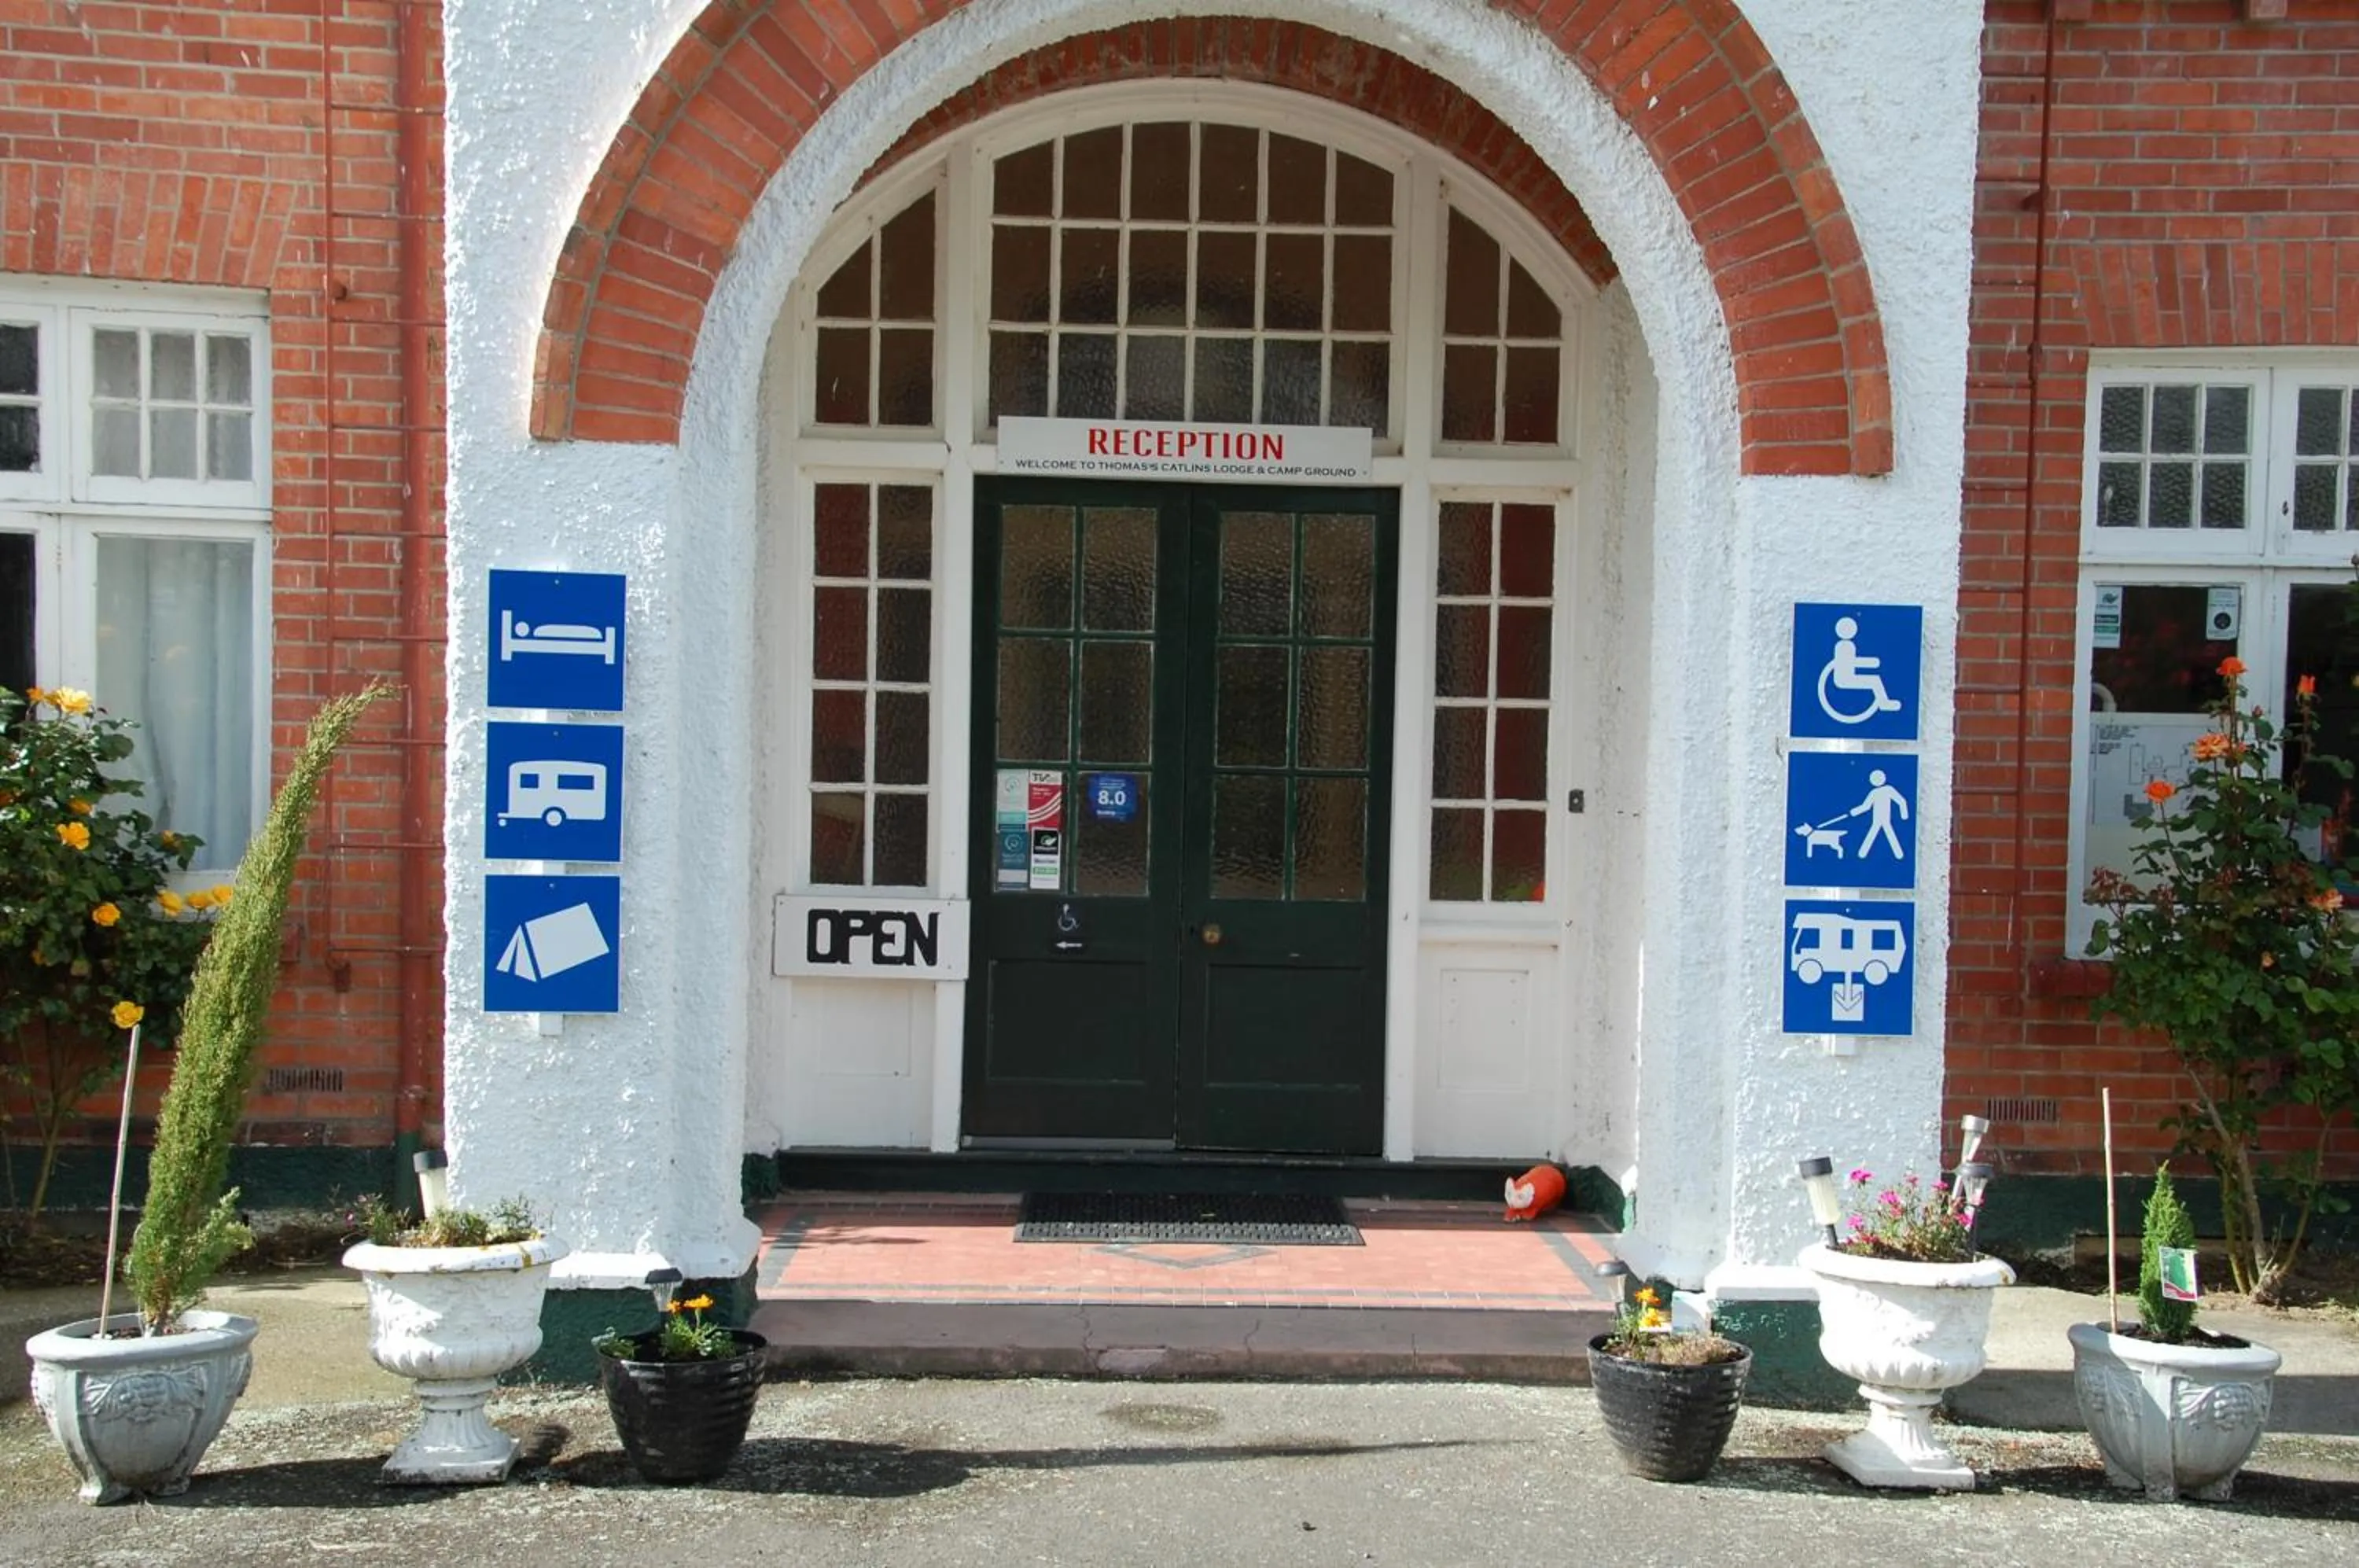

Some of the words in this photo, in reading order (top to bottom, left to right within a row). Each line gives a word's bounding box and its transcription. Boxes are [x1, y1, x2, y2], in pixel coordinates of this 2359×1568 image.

[1088, 428, 1283, 460] RECEPTION
[1015, 458, 1076, 469] WELCOME
[1081, 461, 1095, 470] TO
[1161, 462, 1211, 473] CATLINS
[1213, 464, 1254, 474] LODGE
[1267, 466, 1302, 475] CAMP
[1304, 467, 1356, 477] GROUND
[1098, 790, 1126, 806] 8.0
[807, 908, 940, 966] OPEN
